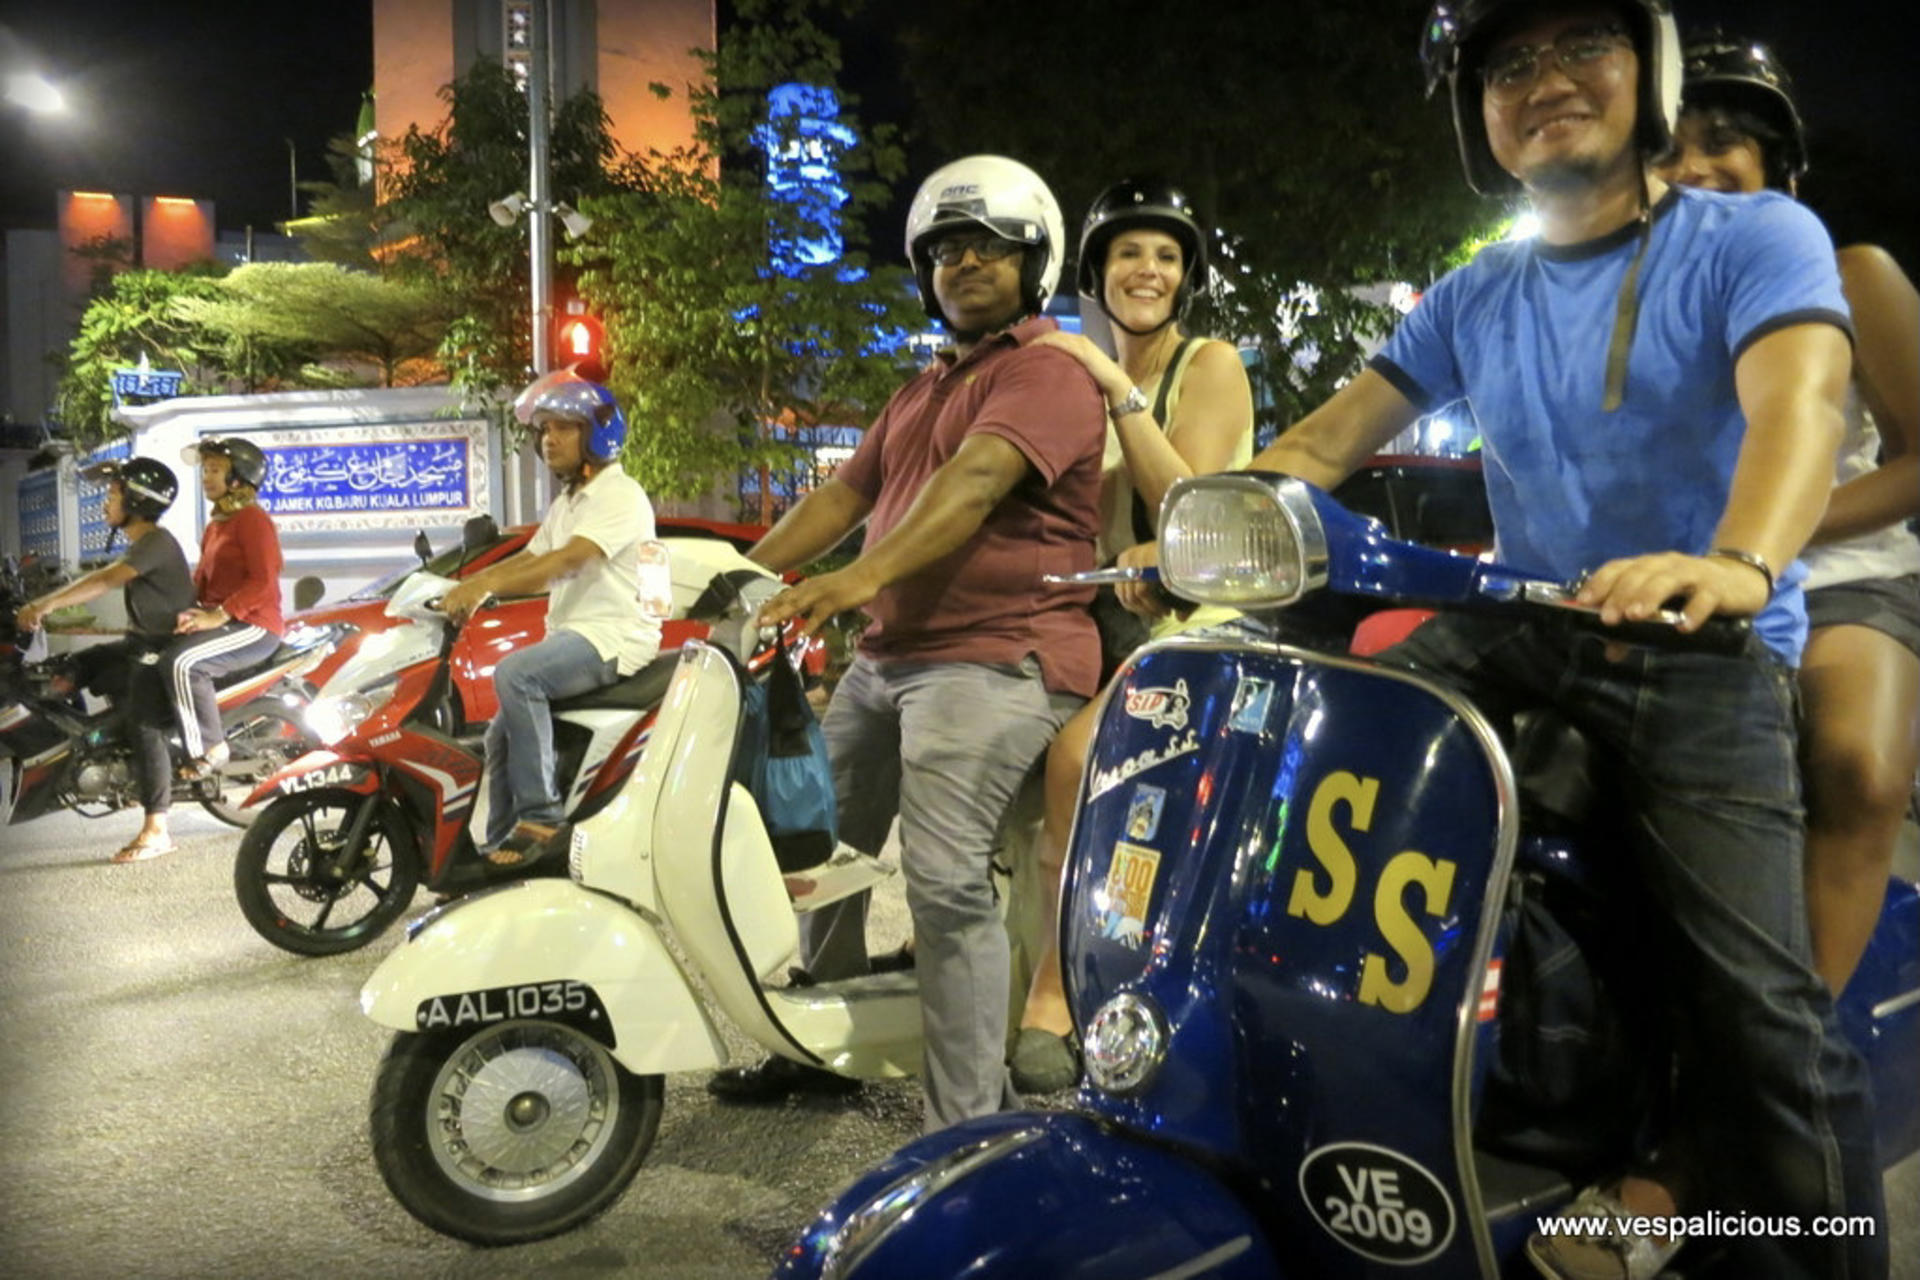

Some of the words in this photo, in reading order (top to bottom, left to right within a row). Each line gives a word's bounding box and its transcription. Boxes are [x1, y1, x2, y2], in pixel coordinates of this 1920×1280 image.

[274, 497, 314, 511] JAMEK
[370, 492, 410, 508] KUALA
[412, 490, 464, 507] LUMPUR
[1128, 693, 1164, 713] SIP
[368, 730, 403, 748] YAMAHA
[1336, 1164, 1405, 1210] VE
[1325, 1196, 1434, 1247] 2009
